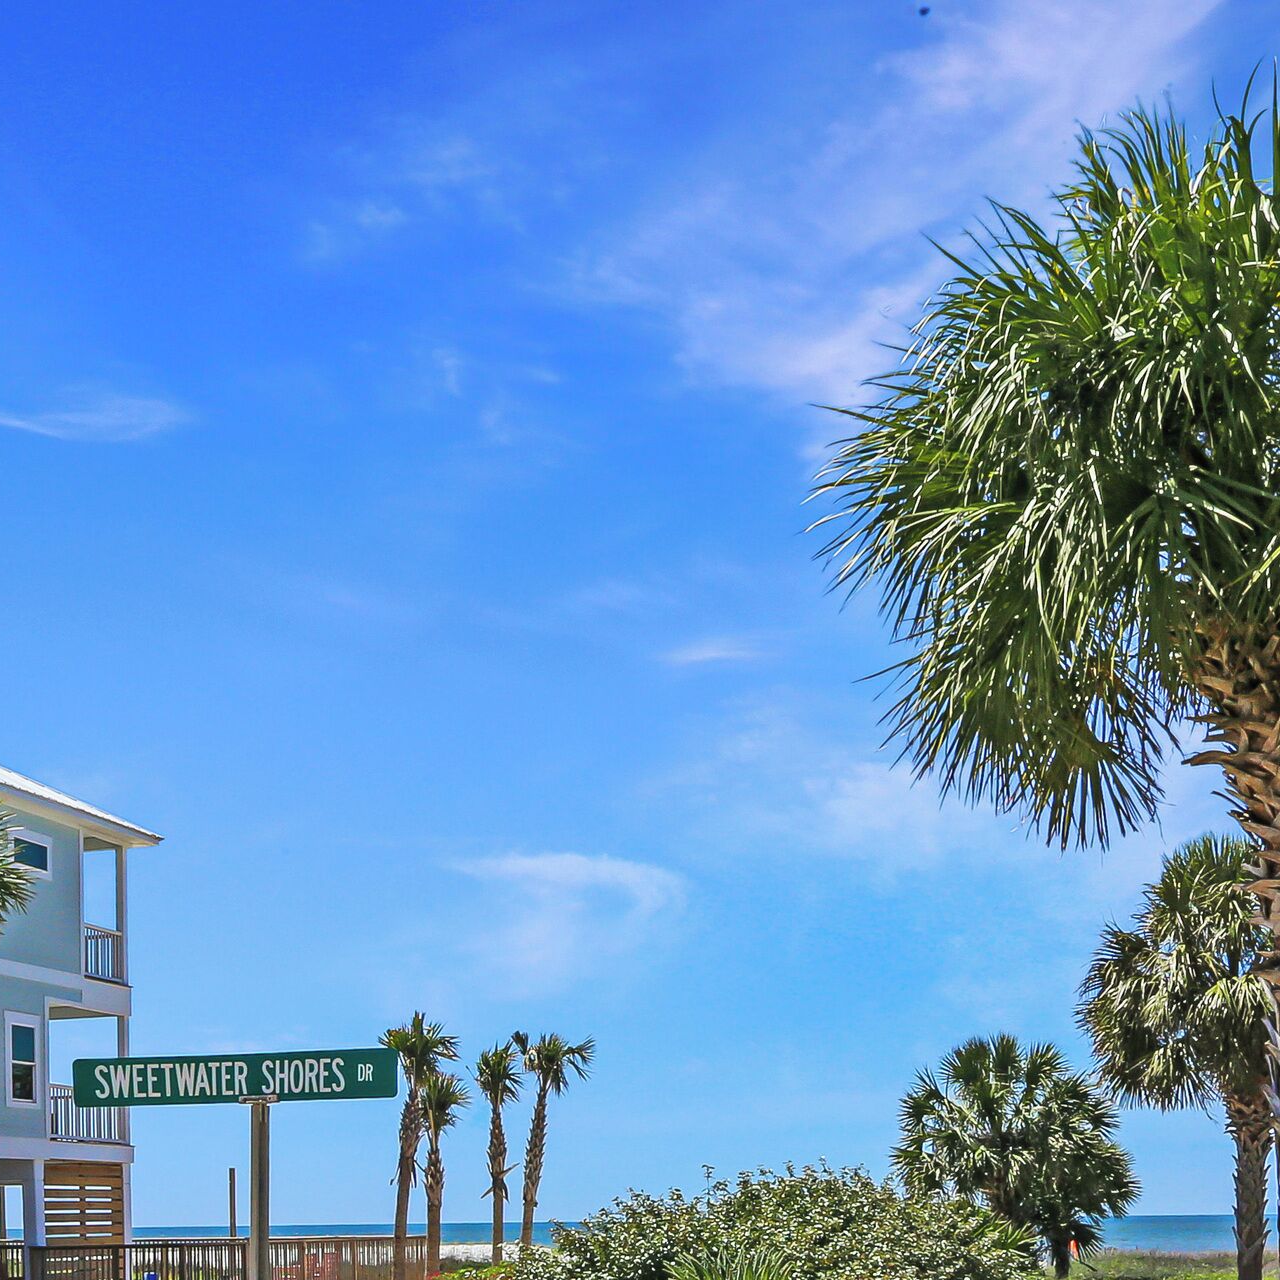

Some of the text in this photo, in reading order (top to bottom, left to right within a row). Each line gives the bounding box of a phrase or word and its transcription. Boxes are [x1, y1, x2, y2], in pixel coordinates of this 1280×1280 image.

[94, 1057, 373, 1099] SWEETWATER SHORES DR
